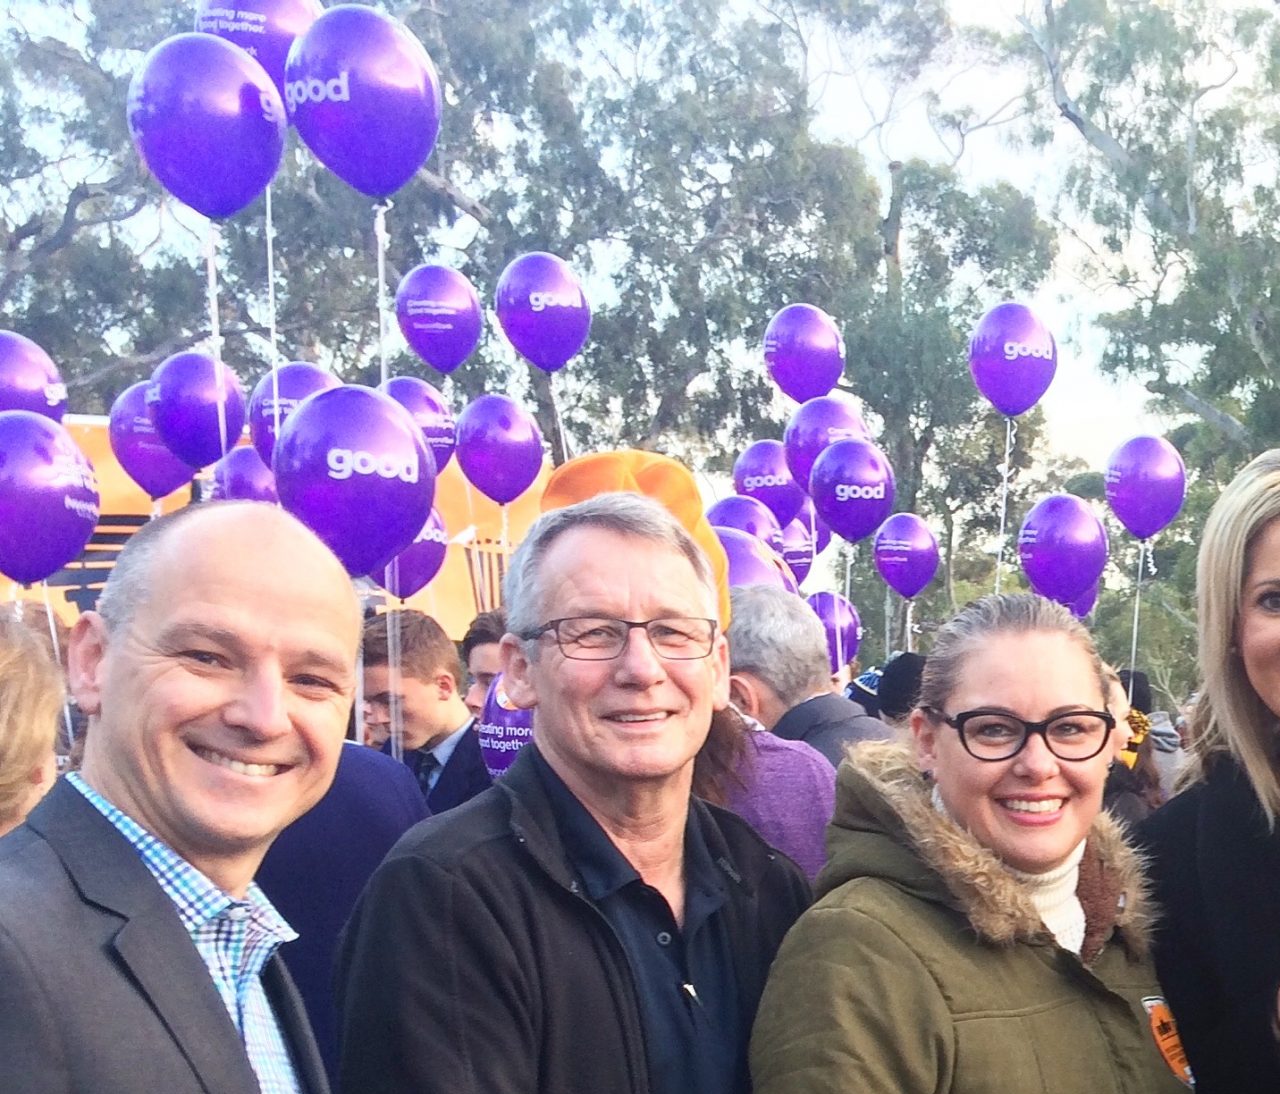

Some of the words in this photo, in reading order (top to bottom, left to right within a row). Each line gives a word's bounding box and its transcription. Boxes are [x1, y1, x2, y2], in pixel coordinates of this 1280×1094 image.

[1003, 338, 1053, 360] good
[327, 447, 419, 483] good
[743, 474, 788, 492] good
[835, 482, 885, 501] good
